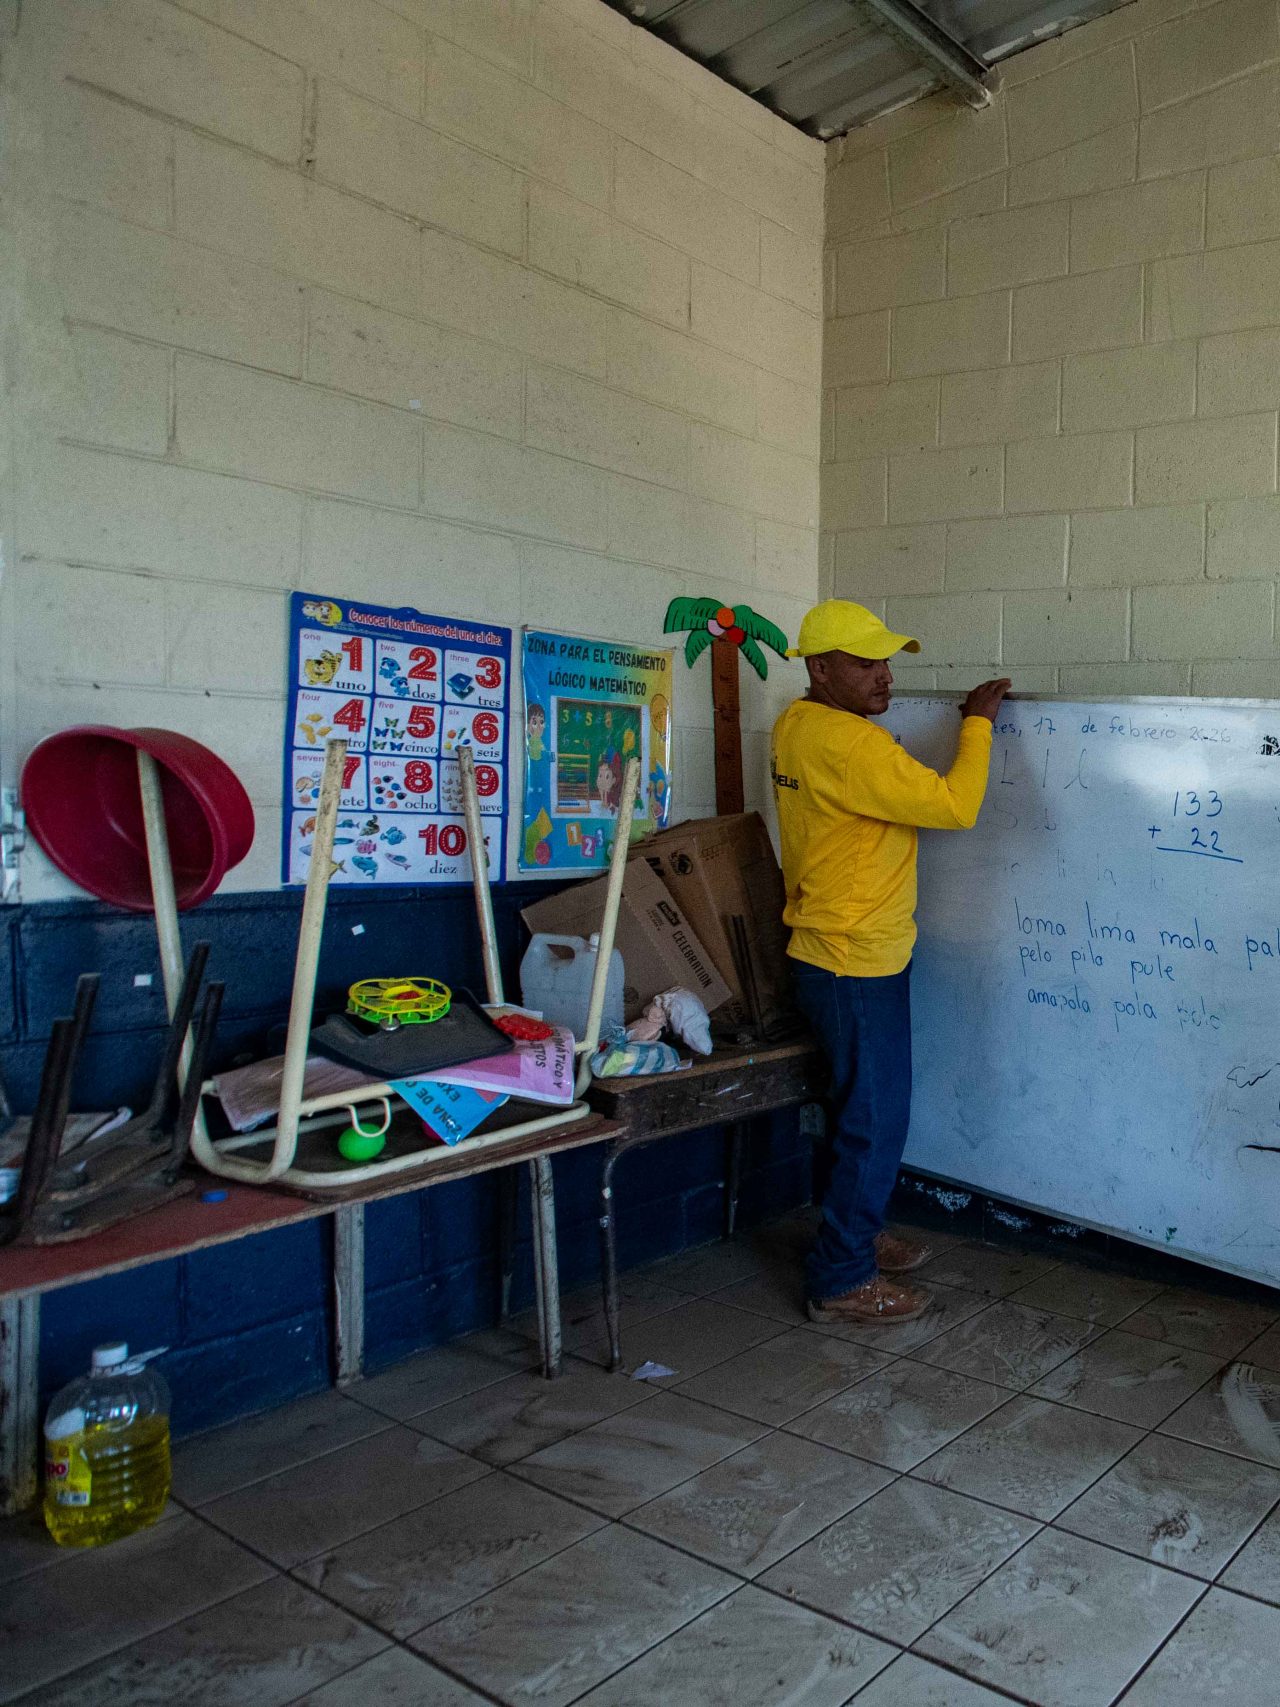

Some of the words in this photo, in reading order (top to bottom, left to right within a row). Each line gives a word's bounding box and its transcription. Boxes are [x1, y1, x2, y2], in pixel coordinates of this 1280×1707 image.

[304, 633, 321, 642] one
[349, 608, 388, 627] Conocer
[389, 615, 403, 629] los
[404, 619, 444, 636] números
[445, 624, 458, 638] del
[459, 629, 476, 642] uno
[476, 631, 486, 643] al
[342, 637, 363, 672] 1
[380, 643, 396, 652] two
[527, 638, 556, 657] ZONA
[560, 643, 590, 661] PARA
[593, 649, 606, 664] EL
[609, 651, 666, 672] PENSAMIENTO
[408, 647, 438, 682] 2
[475, 657, 502, 689] 3
[336, 680, 366, 691] uno
[412, 684, 436, 700] dos
[548, 667, 586, 688] LÓGICO
[590, 676, 647, 696] MATEMÁTICO
[301, 693, 320, 702] four
[378, 700, 394, 710] five
[478, 695, 501, 707] tres
[333, 698, 366, 733] 4
[406, 705, 436, 739] 5
[449, 708, 460, 716] six
[472, 712, 499, 745] 6
[1033, 716, 1057, 735] 17
[1081, 715, 1098, 734] de
[1109, 716, 1177, 740] febrero
[404, 740, 438, 754] cinco
[476, 748, 500, 758] seis
[373, 759, 396, 768] eight
[404, 760, 434, 794] 8
[475, 764, 500, 797] 9
[404, 795, 437, 810] ocho
[480, 804, 502, 812] ueve
[1174, 790, 1224, 817] 133
[418, 824, 467, 857] 10
[584, 838, 592, 856] 2
[1191, 827, 1224, 853] 22
[429, 860, 457, 874] diez
[1014, 897, 1067, 937] loma
[1086, 900, 1136, 944] lima
[1159, 917, 1219, 955] mala
[671, 929, 713, 990] CELEBRATION
[1019, 940, 1052, 977] pelo
[1130, 954, 1176, 985] pule
[1114, 991, 1158, 1032] pola
[416, 1088, 435, 1106] DE
